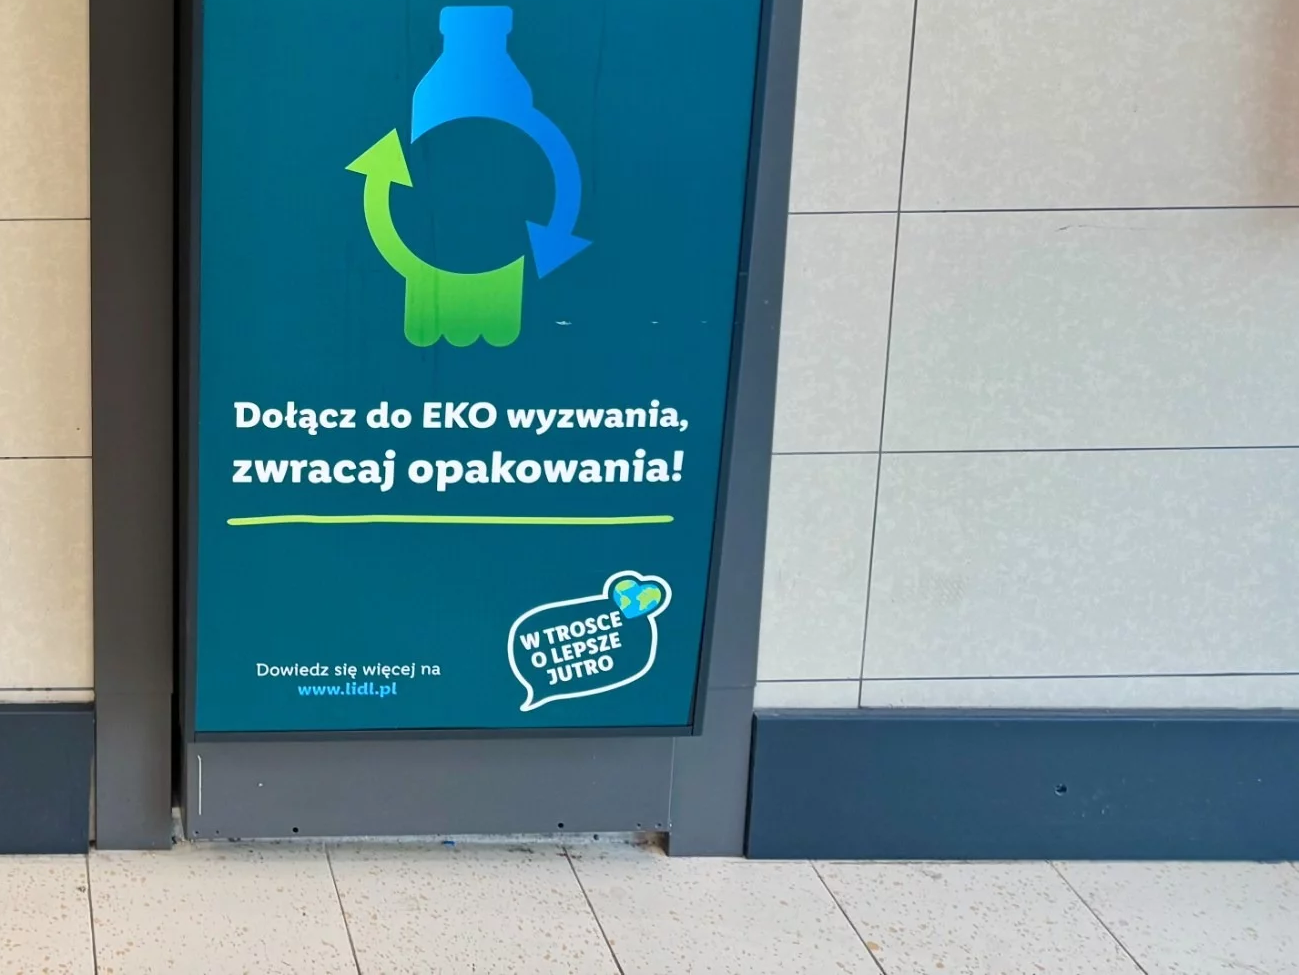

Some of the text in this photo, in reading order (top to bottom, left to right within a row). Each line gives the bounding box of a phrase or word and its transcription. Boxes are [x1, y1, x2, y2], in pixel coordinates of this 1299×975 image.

[234, 399, 688, 435] Dołącz do EKO wyzwania,
[232, 449, 684, 492] zwracaj opakowania!
[520, 610, 622, 650] W TROSCE
[531, 630, 622, 669] O LEPSZE
[256, 663, 440, 679] Dowiedz się więcej na
[546, 654, 614, 685] JUTRO
[298, 682, 396, 697] www.lidl.pl
